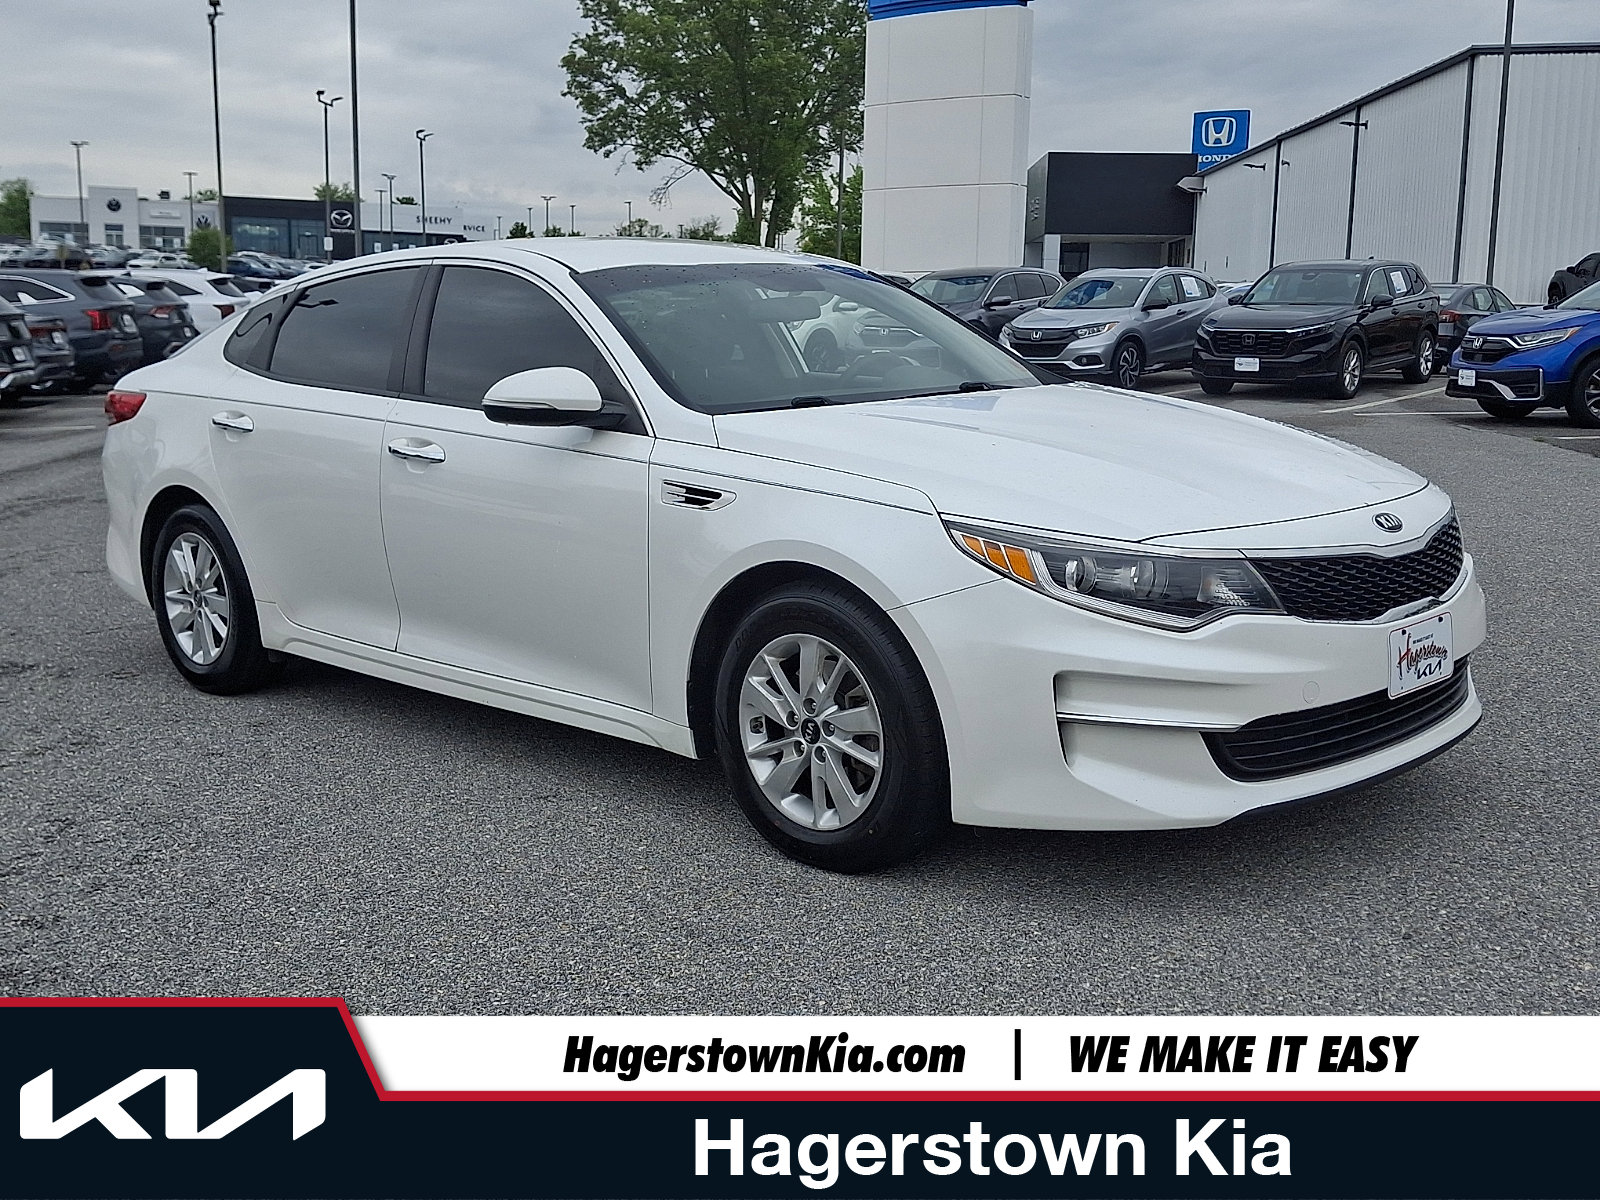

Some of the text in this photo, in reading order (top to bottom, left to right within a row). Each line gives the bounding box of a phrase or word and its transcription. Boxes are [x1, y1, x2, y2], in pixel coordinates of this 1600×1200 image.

[1198, 154, 1232, 163] OND
[1397, 632, 1449, 680] Hagerstown
[804, 722, 816, 742] KIA
